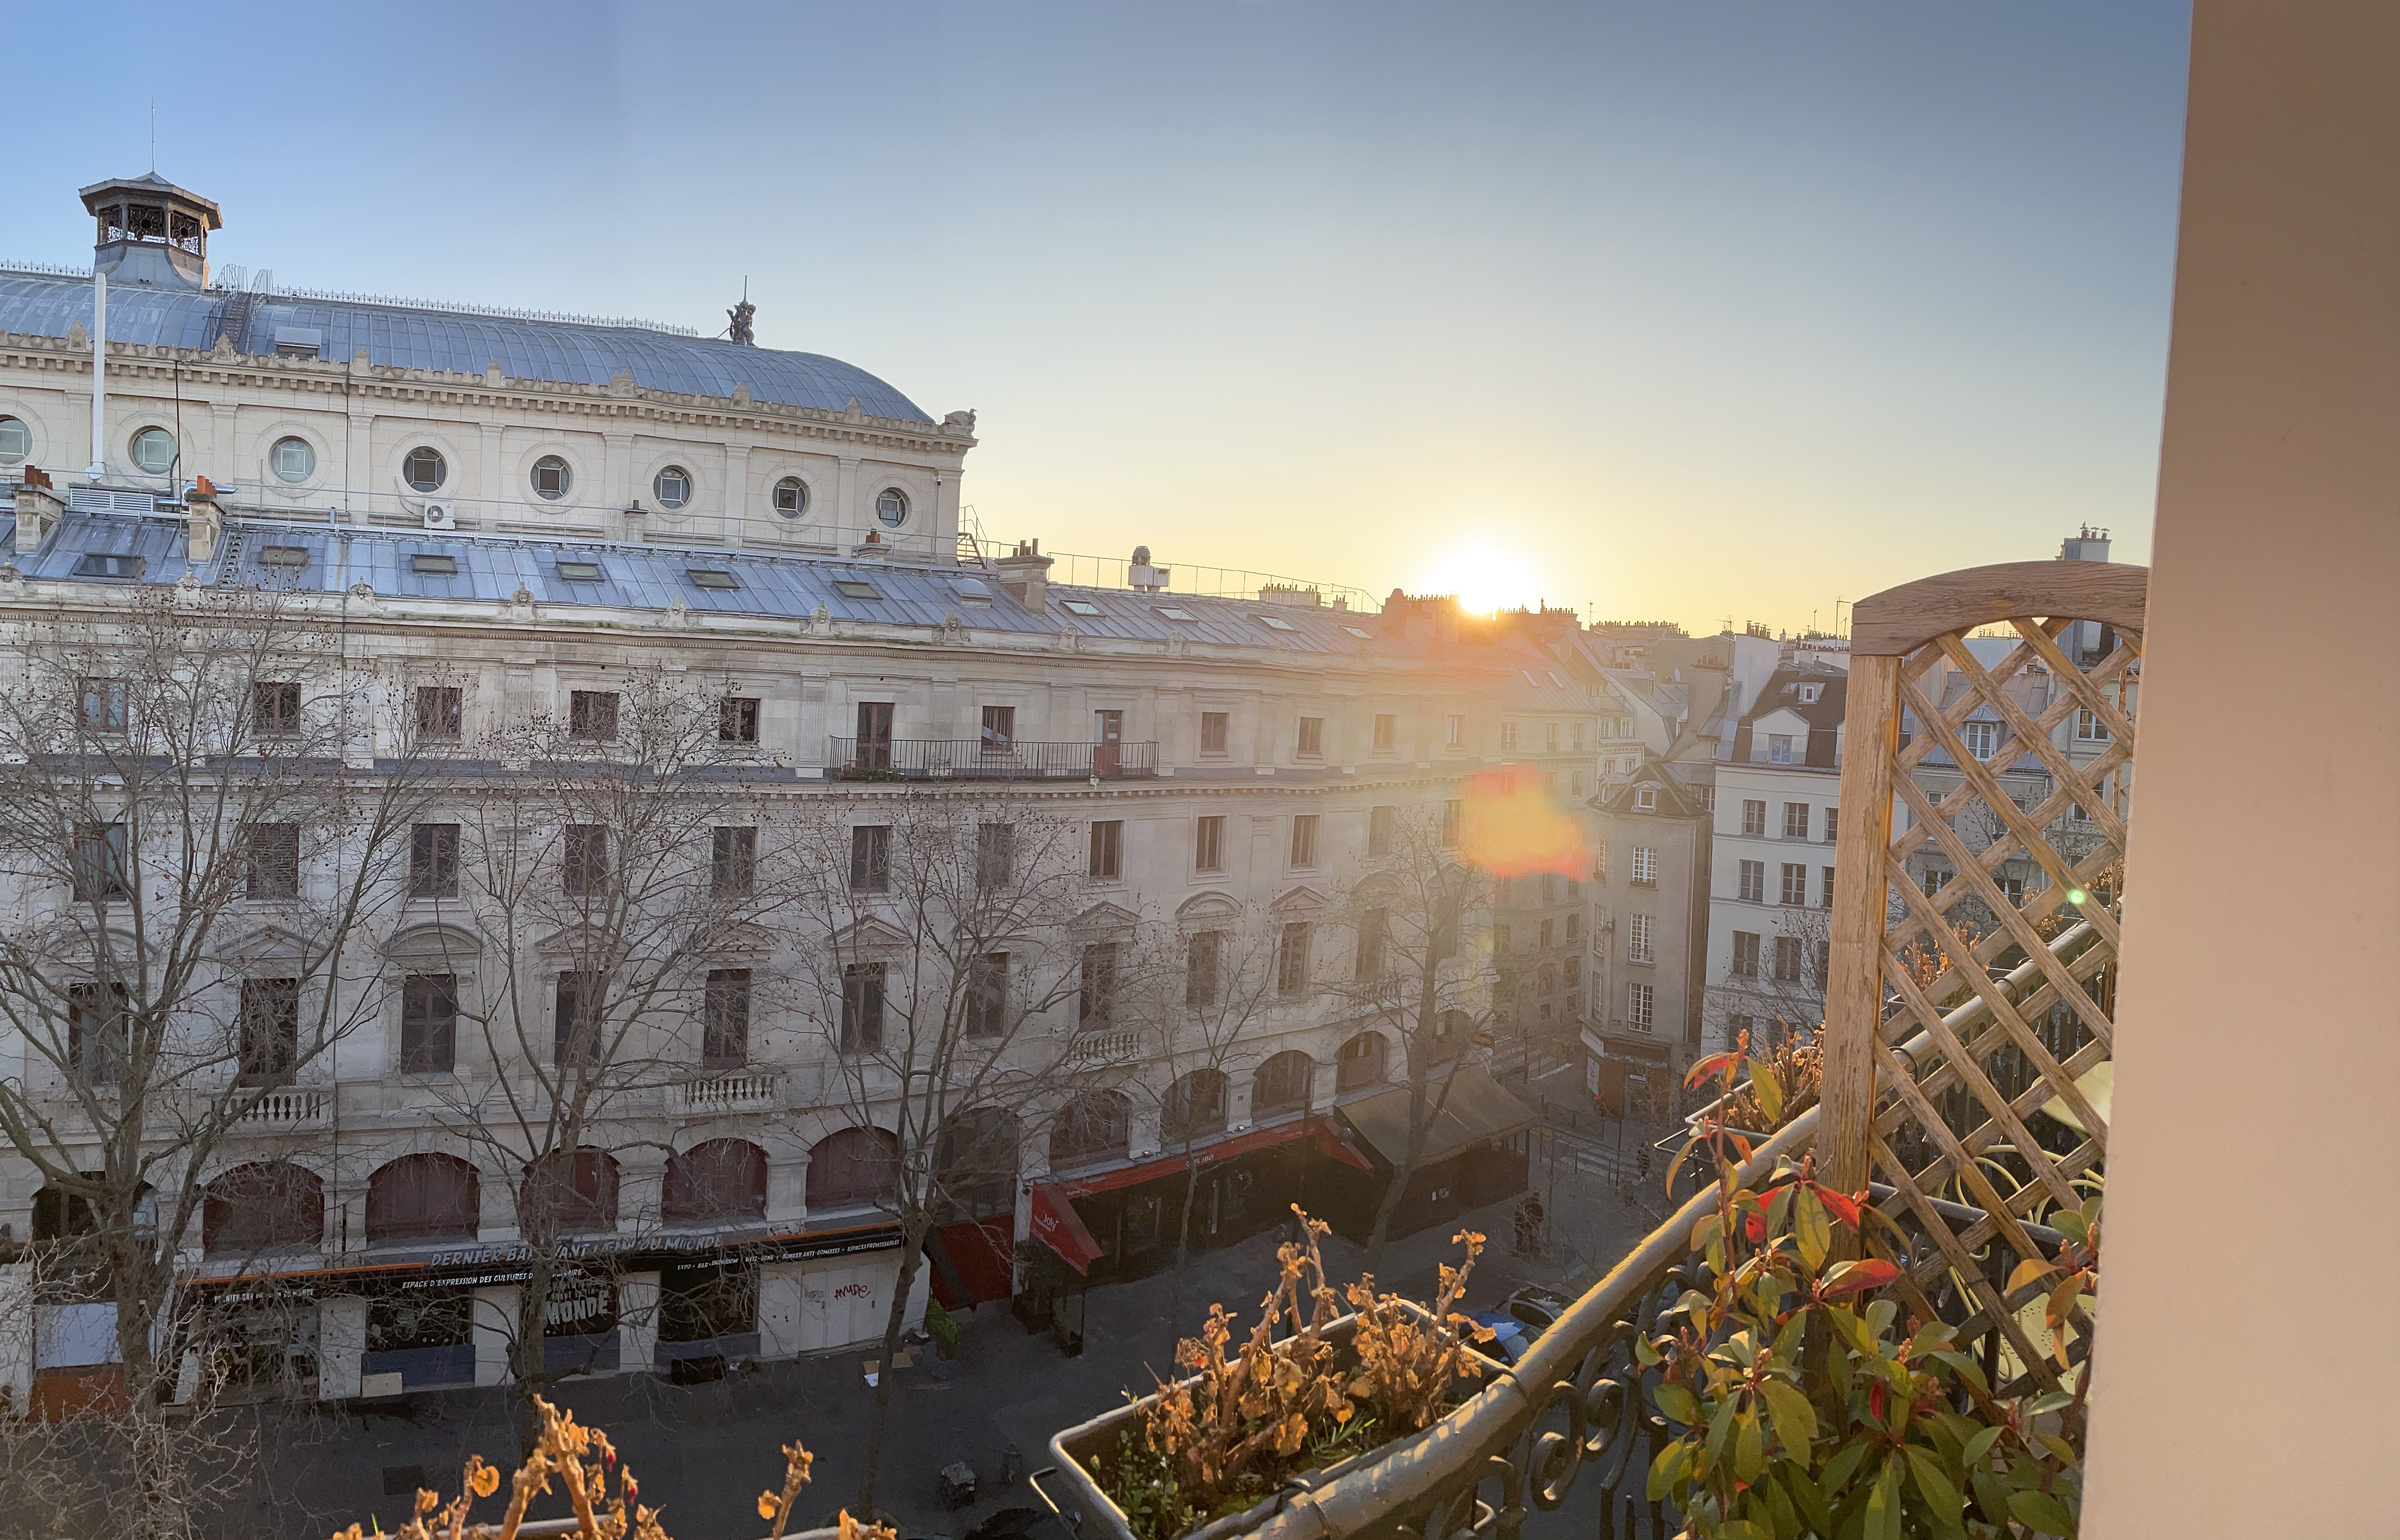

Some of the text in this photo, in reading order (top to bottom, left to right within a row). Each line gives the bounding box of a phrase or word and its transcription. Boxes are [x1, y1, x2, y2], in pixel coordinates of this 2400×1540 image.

[1202, 1154, 1214, 1163] JOLY
[1043, 1213, 1056, 1232] Joly
[430, 1248, 503, 1266] DERNIER
[803, 1248, 840, 1258] ANTI-ZOMBIES
[866, 1239, 900, 1249] PRIVATISABLES
[402, 1280, 428, 1288] ESPACE
[430, 1277, 478, 1287] D'EXPRESSION
[480, 1276, 492, 1284] DES
[494, 1273, 526, 1282] CULTURES
[545, 1290, 609, 1325] MONDE
